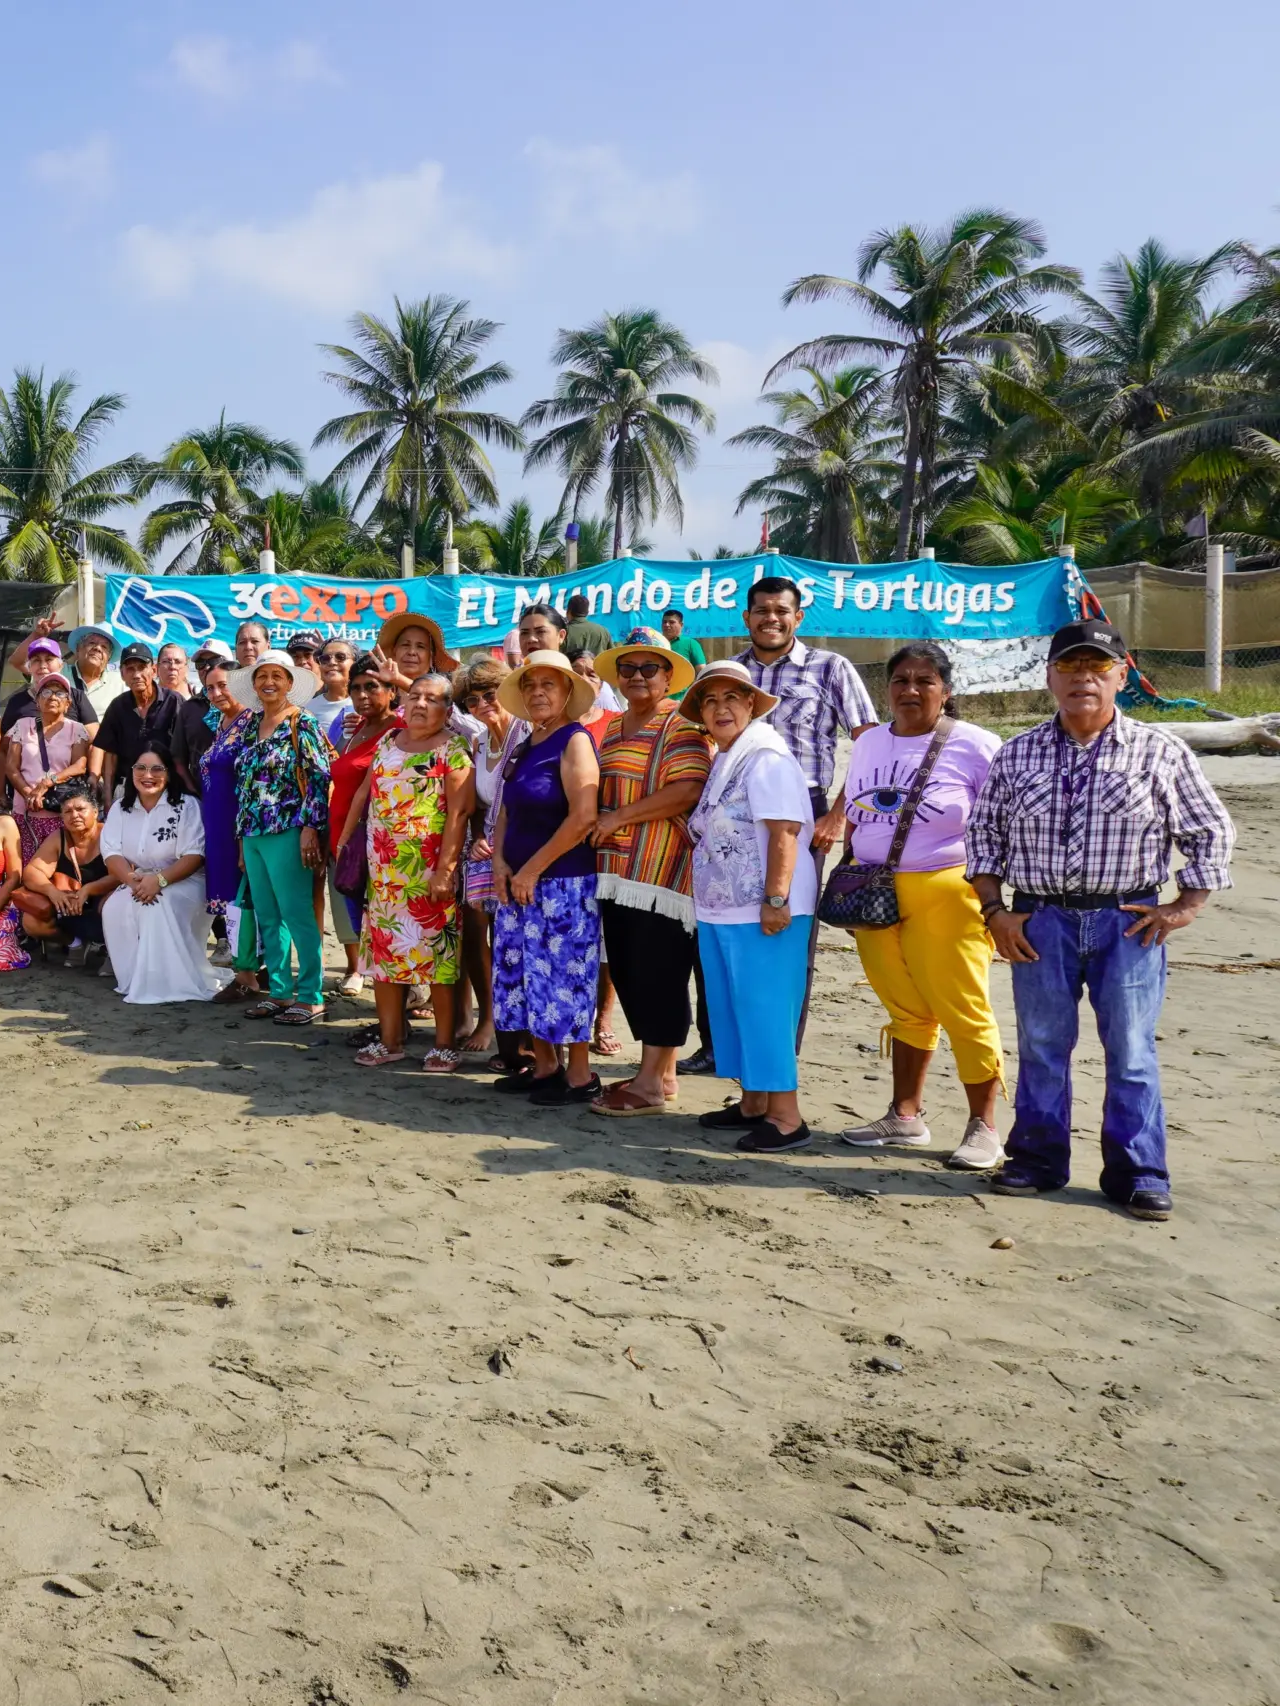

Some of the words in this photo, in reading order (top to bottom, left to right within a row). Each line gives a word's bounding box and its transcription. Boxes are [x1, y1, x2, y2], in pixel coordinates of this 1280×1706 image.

[456, 586, 498, 628] El
[511, 568, 671, 624] Mundo
[683, 567, 737, 610] de
[753, 565, 815, 608] ls
[827, 570, 1016, 625] Tortugas
[326, 623, 380, 641] Mari
